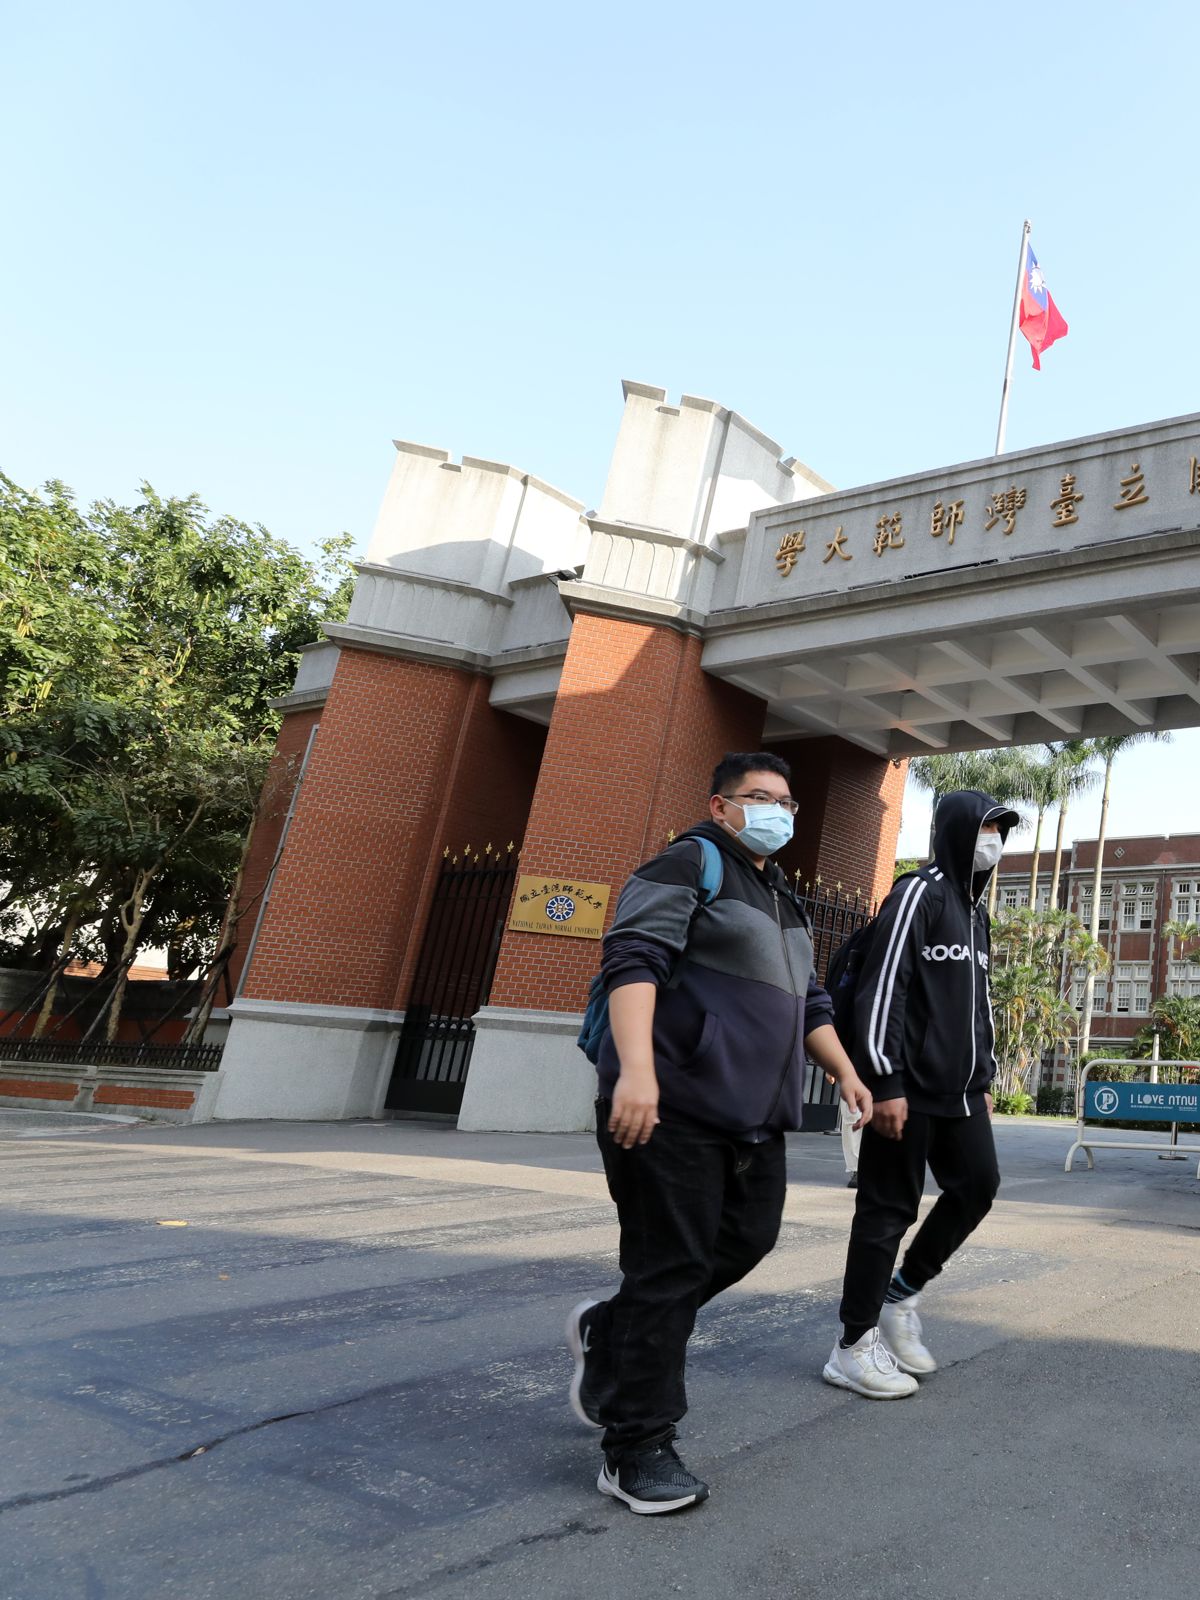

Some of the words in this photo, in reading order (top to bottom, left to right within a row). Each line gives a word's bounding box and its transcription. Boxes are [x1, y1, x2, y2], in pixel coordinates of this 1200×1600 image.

[512, 920, 533, 928] NATIONAL
[535, 921, 552, 930] TAIWAN
[554, 924, 572, 932] NORMAL
[573, 926, 599, 935] UNIVERSITY
[1130, 1094, 1134, 1103] I
[1137, 1094, 1164, 1105] LOVE
